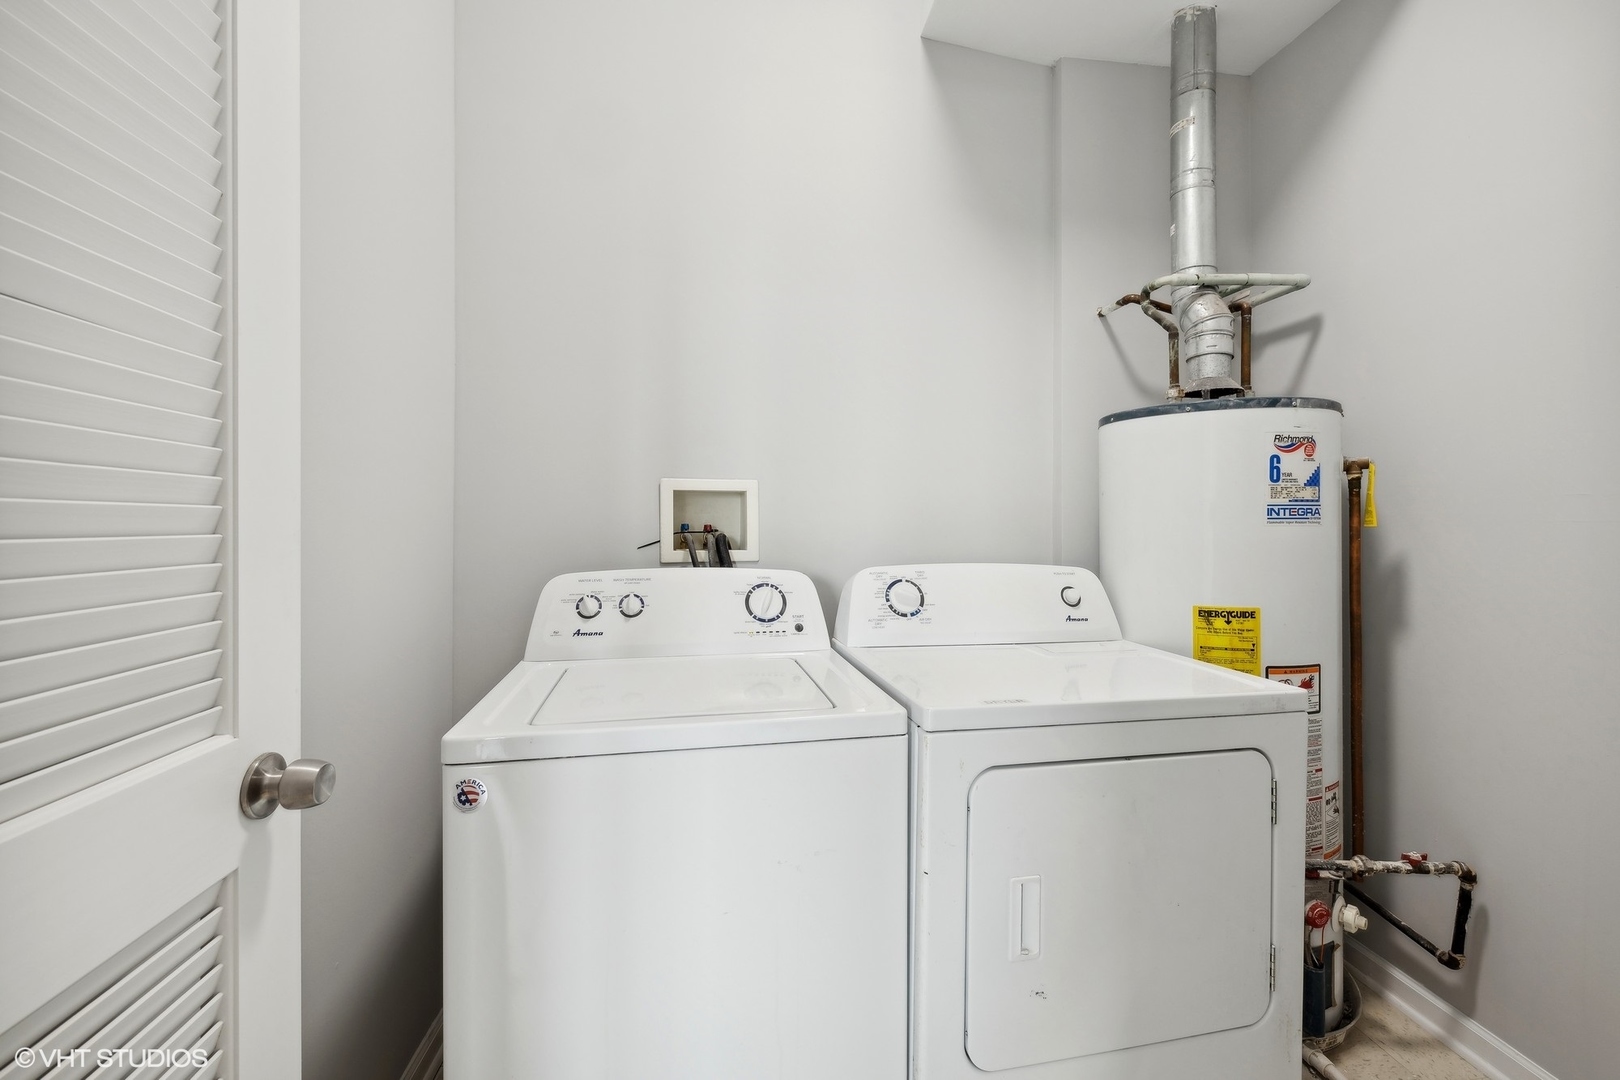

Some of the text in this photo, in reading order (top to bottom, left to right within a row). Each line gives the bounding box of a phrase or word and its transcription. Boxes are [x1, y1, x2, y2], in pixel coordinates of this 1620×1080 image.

[1274, 434, 1314, 444] Richmond
[1269, 454, 1281, 484] 6
[1267, 507, 1321, 517] INTEGRA
[1066, 614, 1089, 622] Amana
[572, 628, 604, 637] Amana
[455, 779, 486, 796] AMERICA
